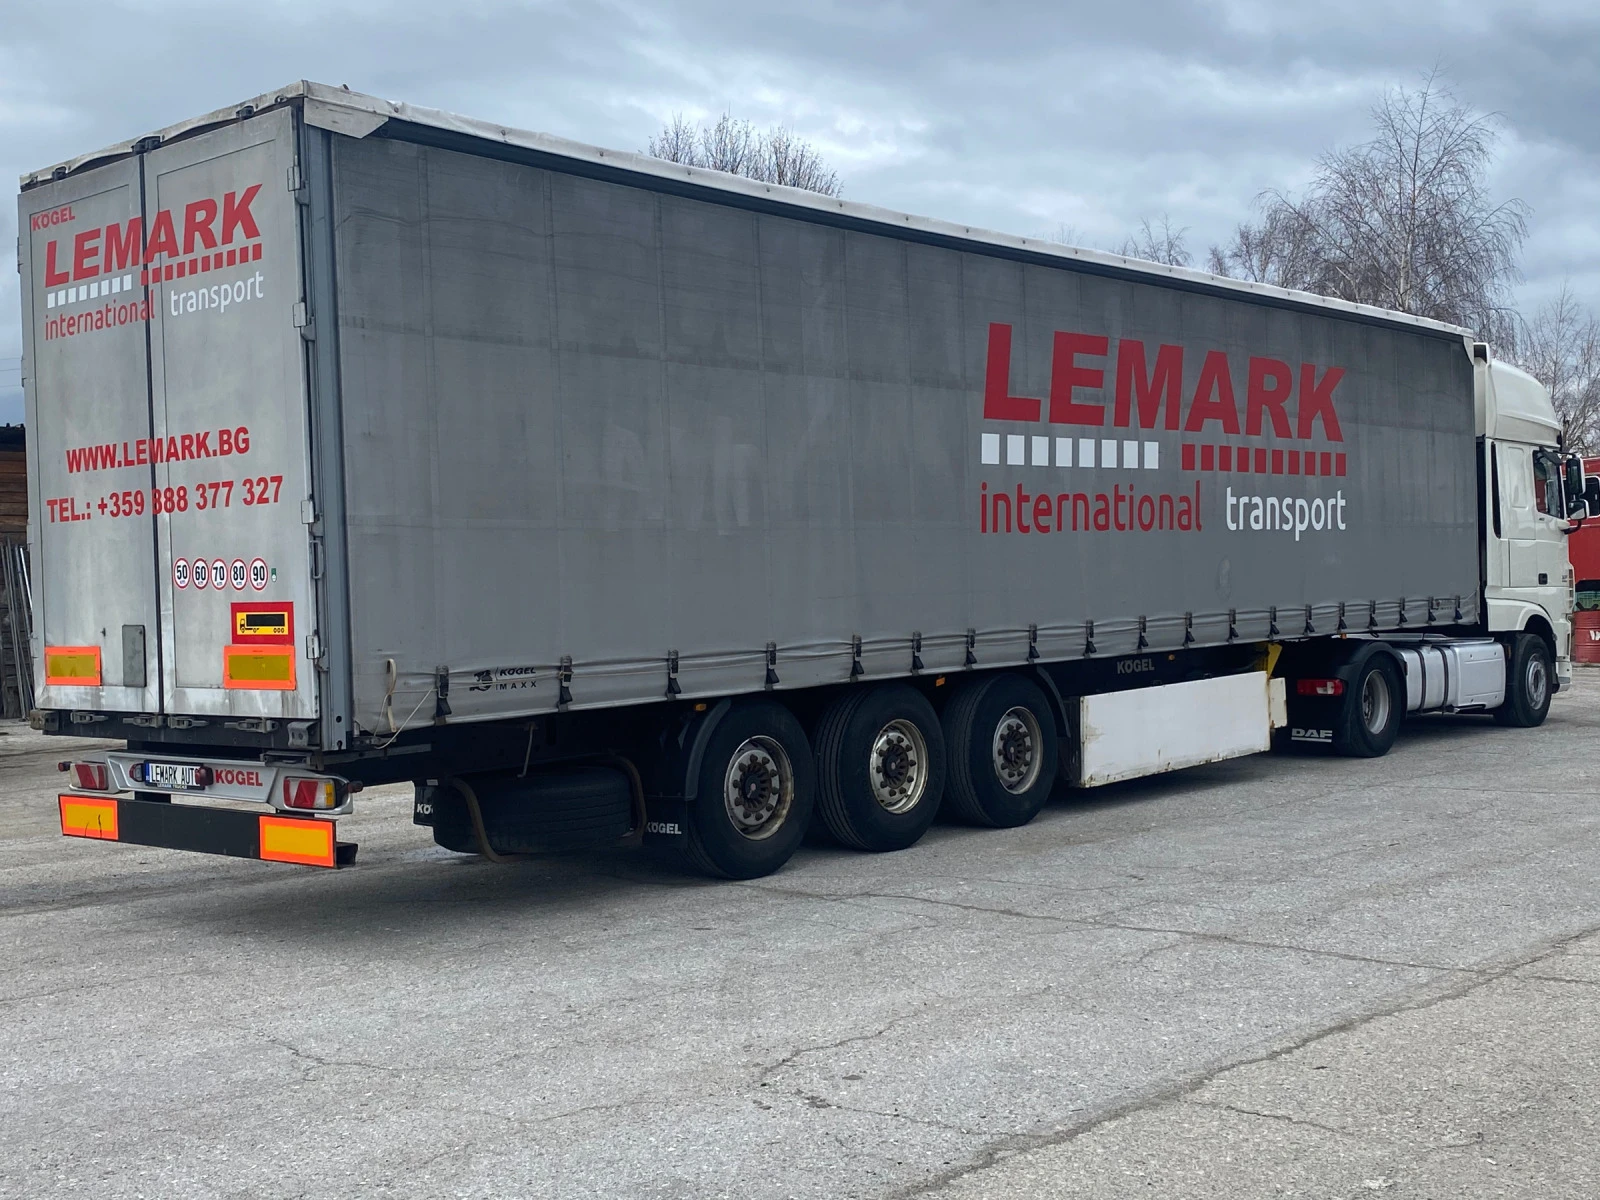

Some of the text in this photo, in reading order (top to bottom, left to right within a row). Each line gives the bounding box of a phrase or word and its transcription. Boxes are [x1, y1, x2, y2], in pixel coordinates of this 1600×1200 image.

[31, 207, 76, 231] KÖGEL
[45, 184, 262, 288] LEMARK
[45, 271, 264, 341] international transport
[983, 322, 1346, 442] LEMARK
[66, 426, 250, 473] WWW.LEMARK.BG
[47, 475, 283, 523] TEL.: +359 888 377 327
[980, 480, 1346, 541] international transport
[176, 564, 188, 580] 50
[195, 565, 206, 581] 60
[213, 565, 225, 582] 70
[233, 565, 245, 581] 80
[253, 565, 265, 582] 90
[1117, 658, 1155, 674] KÖGEL
[499, 681, 537, 690] MAXX
[1291, 728, 1333, 738] DAF
[151, 765, 178, 783] LEMARK
[215, 769, 263, 787] KÖGEL
